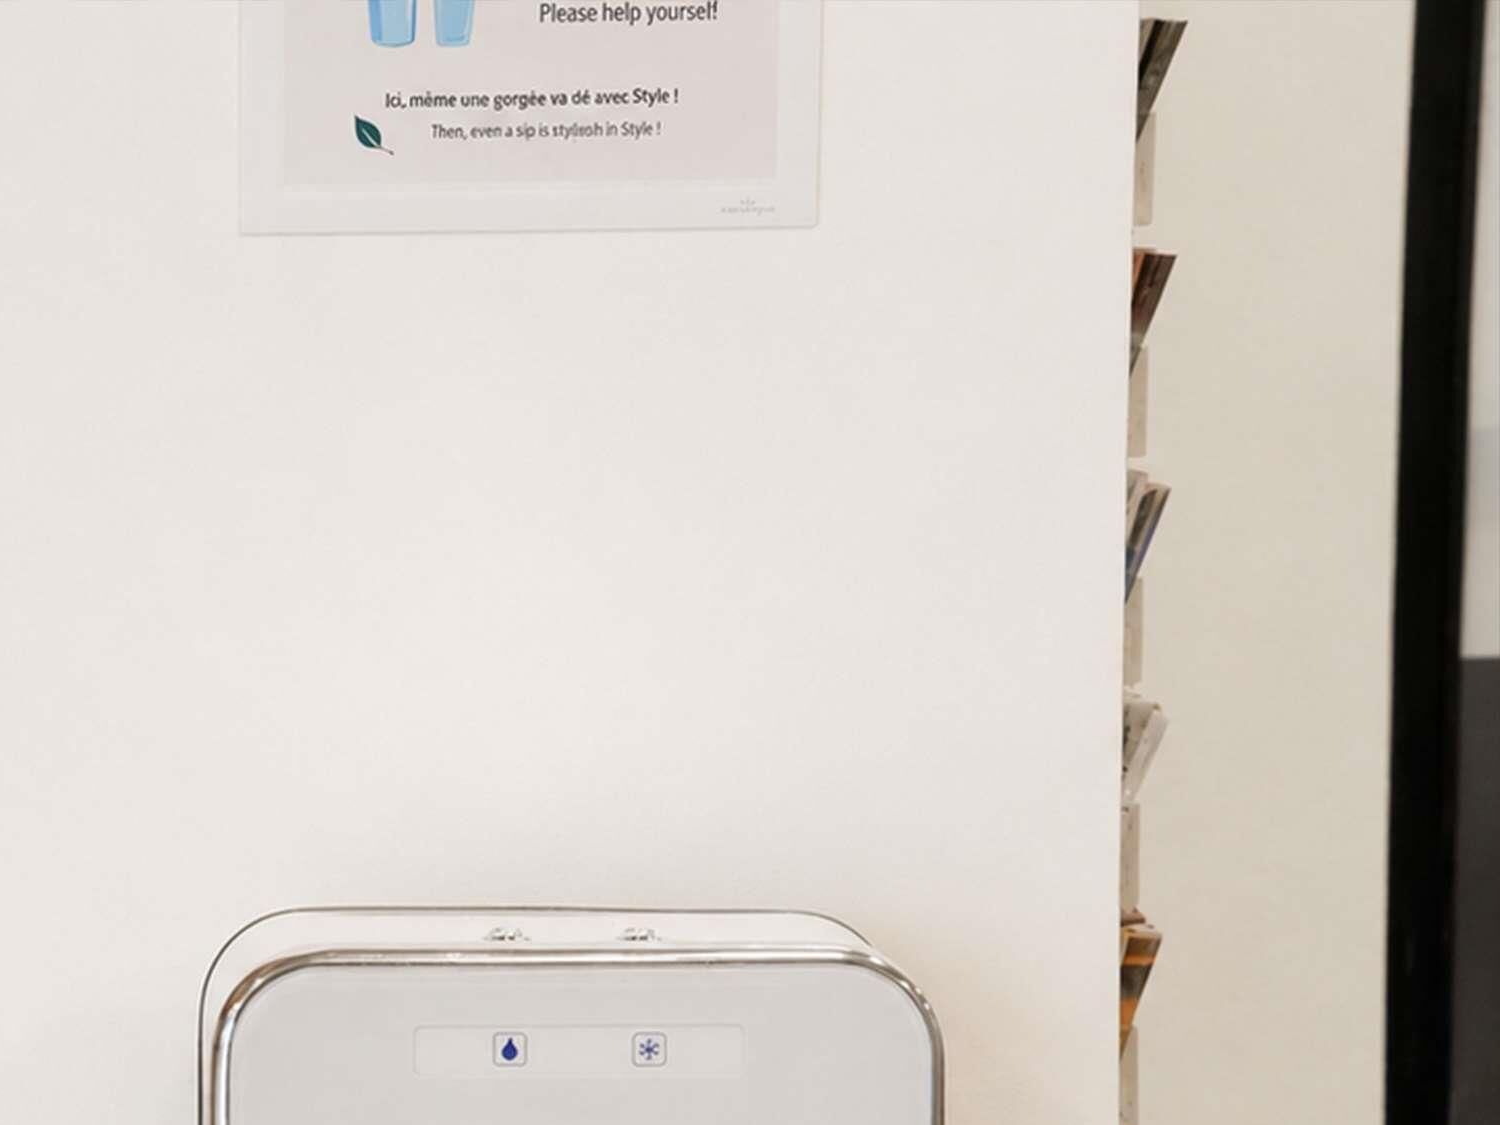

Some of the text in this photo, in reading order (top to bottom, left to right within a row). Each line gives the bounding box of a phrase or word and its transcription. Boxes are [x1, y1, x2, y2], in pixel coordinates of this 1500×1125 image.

[539, 2, 598, 23] Please
[601, 1, 642, 26] help
[460, 94, 490, 107] une
[550, 93, 569, 106] va
[594, 91, 630, 105] avec
[632, 87, 671, 108] Style
[432, 123, 468, 141] Then,
[470, 125, 502, 139] even
[504, 126, 514, 138] a
[516, 122, 536, 141] sip
[538, 122, 551, 137] is
[605, 121, 619, 137] in
[620, 120, 654, 140] Style
